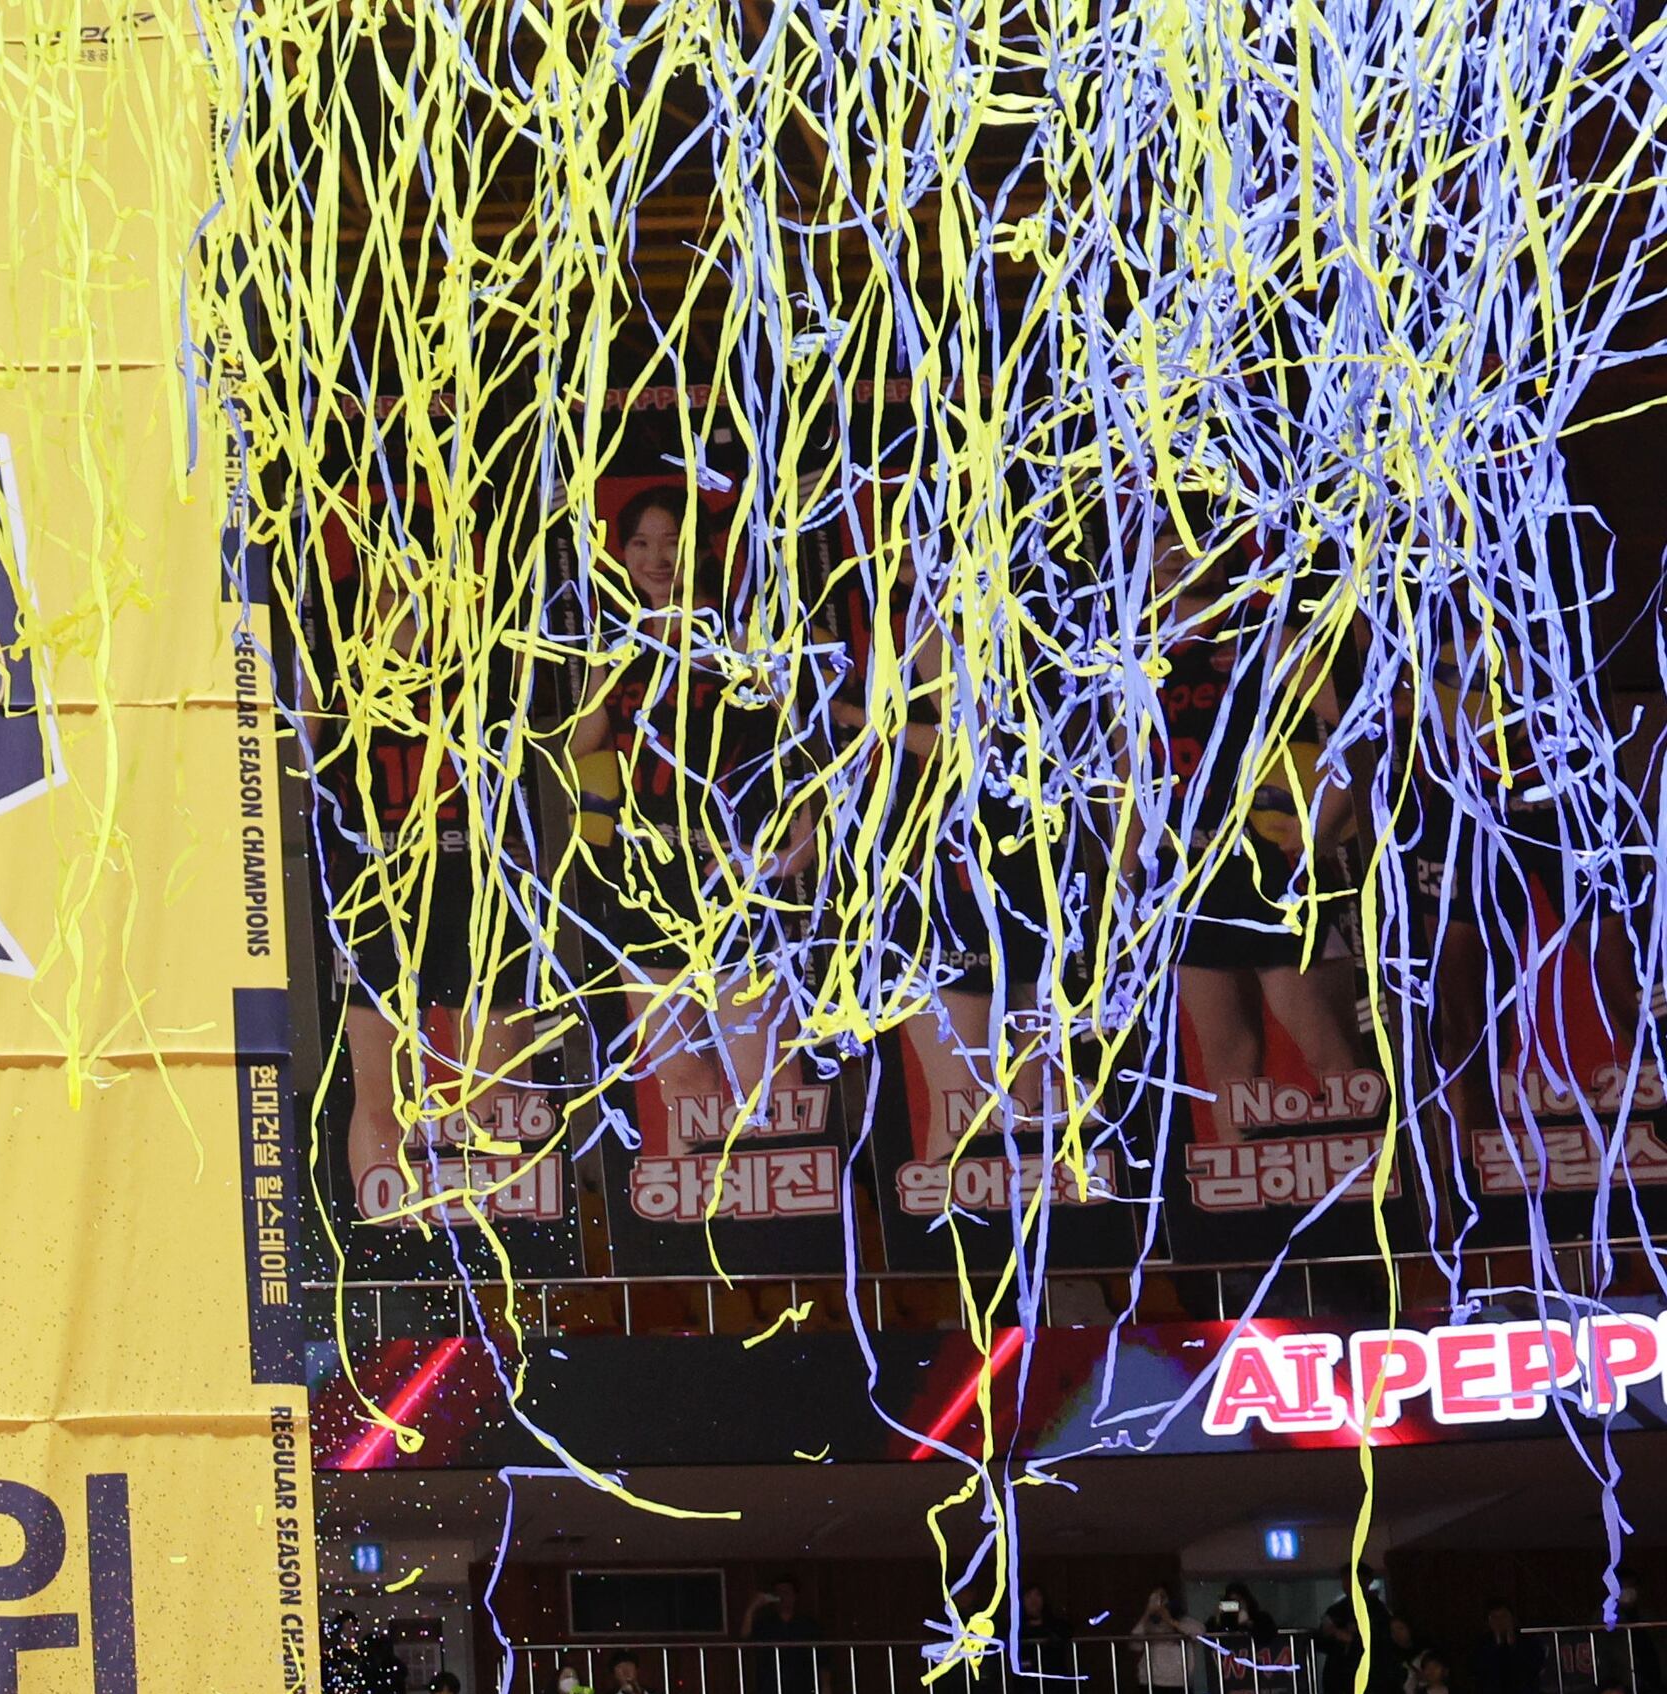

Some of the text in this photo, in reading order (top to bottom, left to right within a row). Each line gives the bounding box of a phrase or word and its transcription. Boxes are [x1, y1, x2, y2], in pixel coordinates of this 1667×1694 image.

[234, 631, 271, 957] REGULAR SEASON CHAMPIONS
[674, 1086, 830, 1139] No.17
[1227, 1067, 1386, 1126] No.19
[1500, 1064, 1667, 1116] No.23
[250, 1064, 288, 1306] 현대건설 힐스테이트
[631, 1146, 841, 1223] 하혜진
[1202, 1333, 1346, 1437] AI
[270, 1405, 296, 1498] REGULAR
[275, 1501, 301, 1606] SEASON
